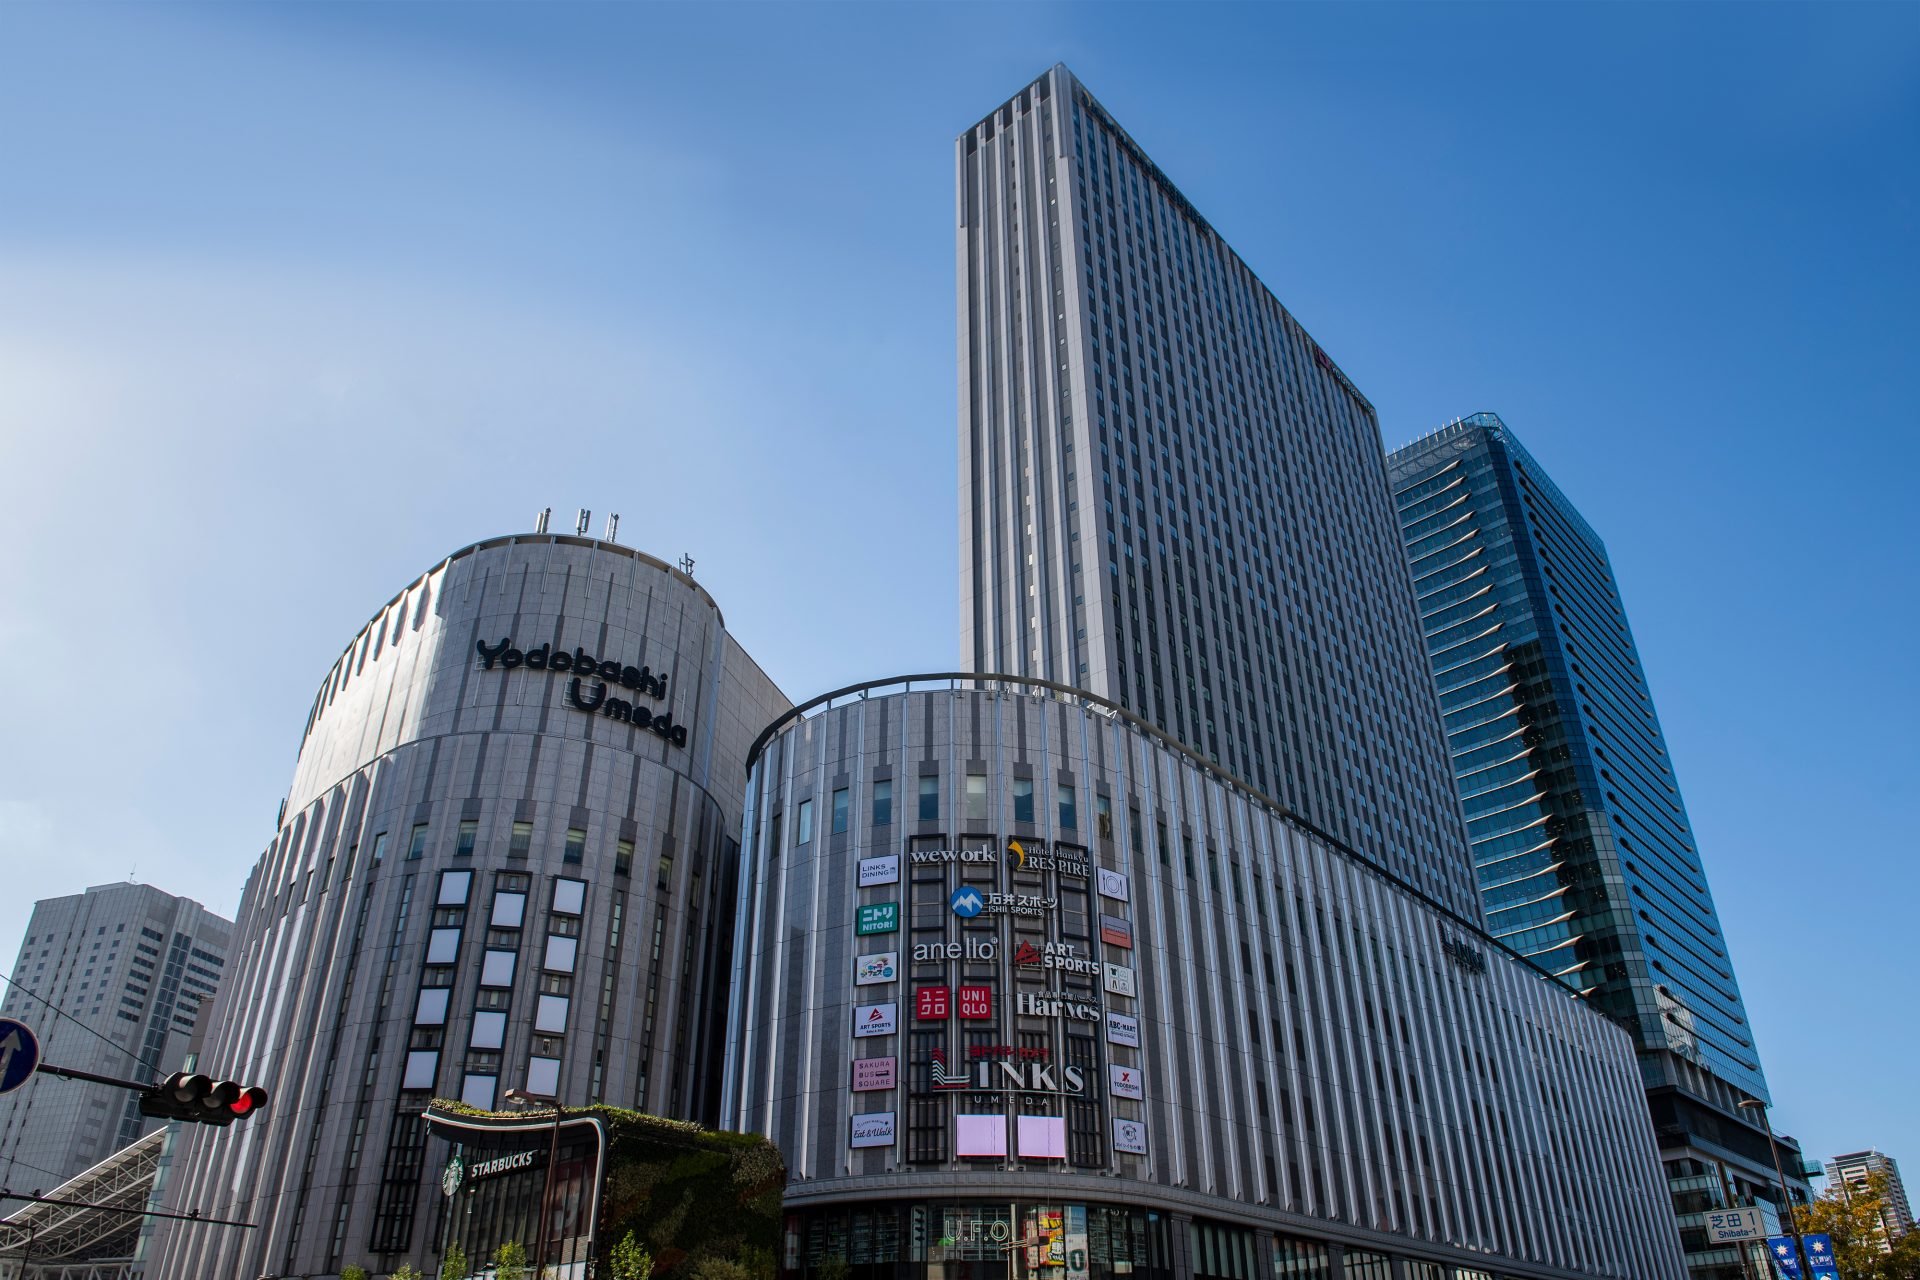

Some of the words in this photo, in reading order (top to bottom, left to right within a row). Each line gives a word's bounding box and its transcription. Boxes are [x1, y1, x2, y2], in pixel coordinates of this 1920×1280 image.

[476, 637, 668, 700] Yodobashi
[570, 677, 687, 748] Umeda
[910, 844, 997, 862] wework
[1028, 846, 1053, 856] Hotel
[1056, 850, 1089, 863] Hankyu
[862, 864, 886, 872] LINKS
[1029, 856, 1090, 877] RESPIRE
[862, 870, 889, 879] DINING
[863, 906, 893, 922] ニトリ
[988, 905, 1008, 913] ISHII
[1011, 906, 1044, 917] SPORTS
[863, 921, 893, 931] NITORI
[1044, 941, 1075, 957] ART
[1044, 956, 1100, 975] SPORTS
[962, 990, 985, 1002] UNI
[962, 1003, 987, 1016] QLO
[1016, 992, 1100, 1022] Harves
[1108, 1020, 1136, 1033] ABC-MART
[859, 1061, 890, 1070] SAKURA
[859, 1071, 875, 1079] BUS
[859, 1079, 890, 1088] SQUARE
[1114, 1081, 1139, 1091] YODOBASHI
[974, 1095, 1048, 1106] UMEDA
[472, 1151, 533, 1178] STARBUCKS
[1710, 1213, 1743, 1230] 芝田
[1747, 1211, 1756, 1226] 1
[1718, 1227, 1757, 1239] Shibata-1
